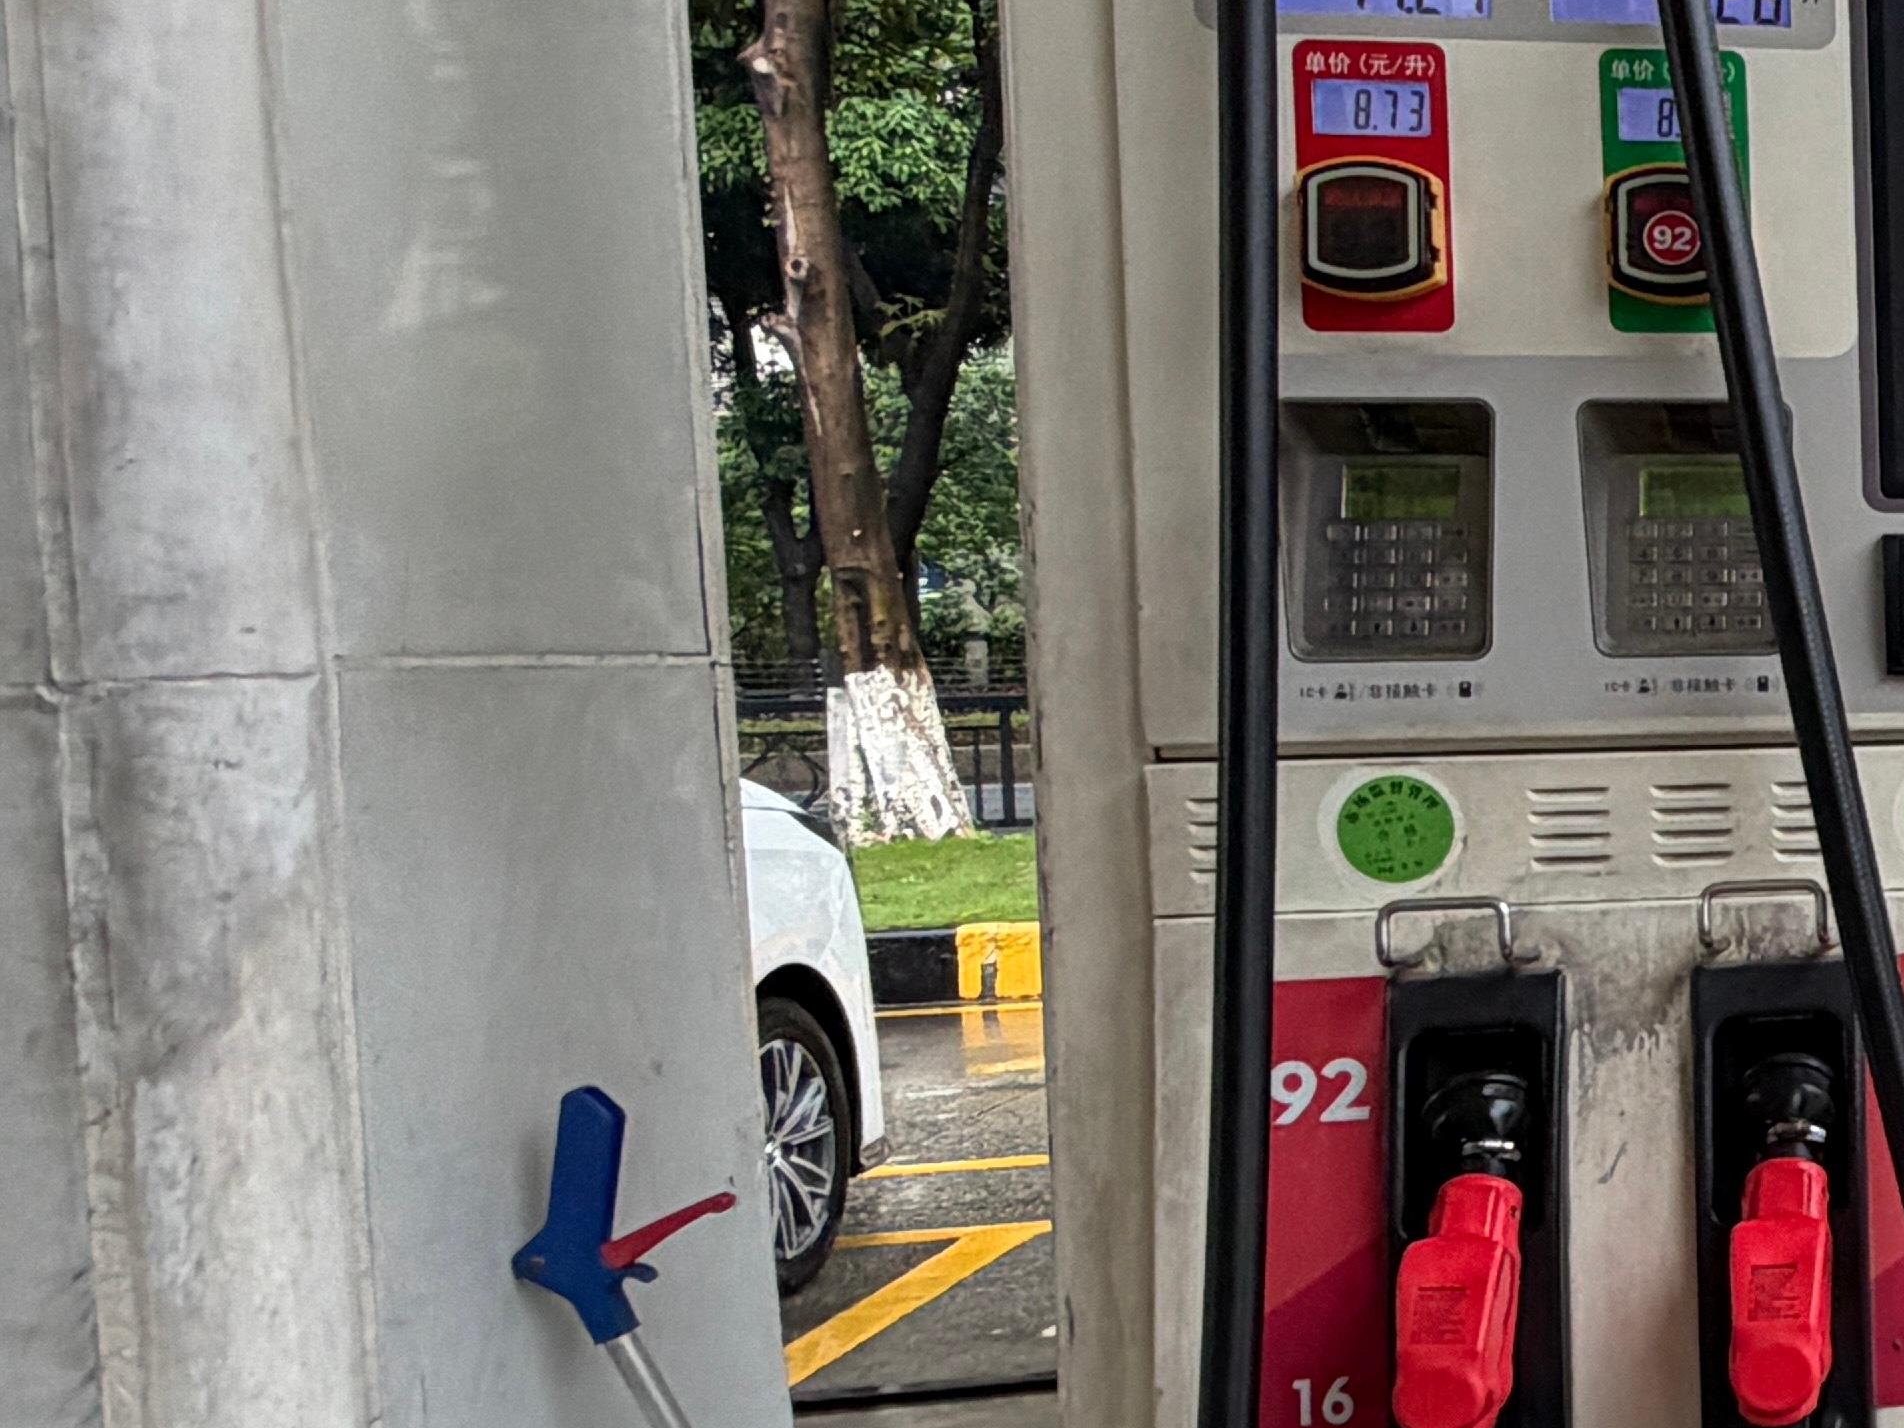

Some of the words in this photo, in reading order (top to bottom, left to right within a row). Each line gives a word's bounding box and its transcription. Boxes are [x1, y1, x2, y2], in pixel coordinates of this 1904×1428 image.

[1354, 88, 1425, 132] 8.73
[1652, 225, 1693, 251] 92
[1270, 1058, 1371, 1126] 92
[1292, 1376, 1355, 1426] 16
